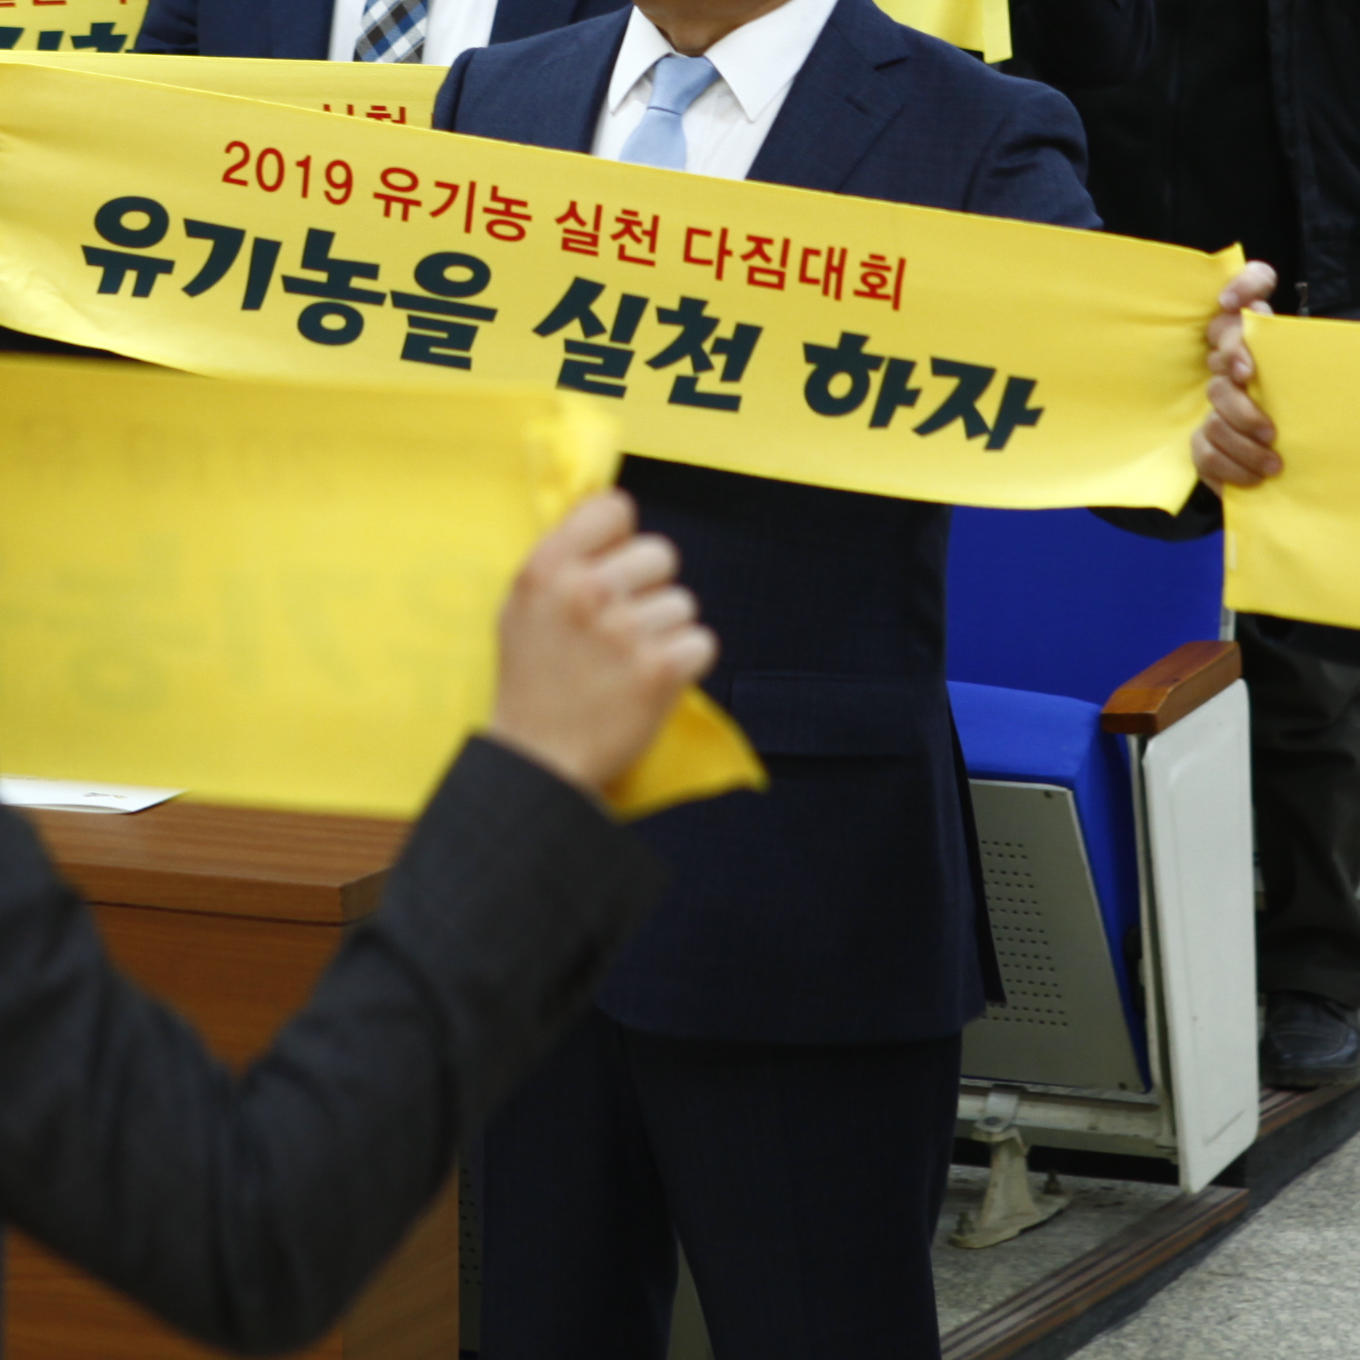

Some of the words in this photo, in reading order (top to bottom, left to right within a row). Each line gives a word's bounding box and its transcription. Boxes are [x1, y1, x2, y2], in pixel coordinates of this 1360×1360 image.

[81, 195, 498, 371] 유기농을
[532, 276, 764, 414] 실천
[802, 330, 1046, 452] 하자
[221, 141, 354, 206] 2019
[372, 166, 533, 243] 유기농
[554, 199, 662, 267] 실천
[682, 225, 908, 312] 다짐대회
